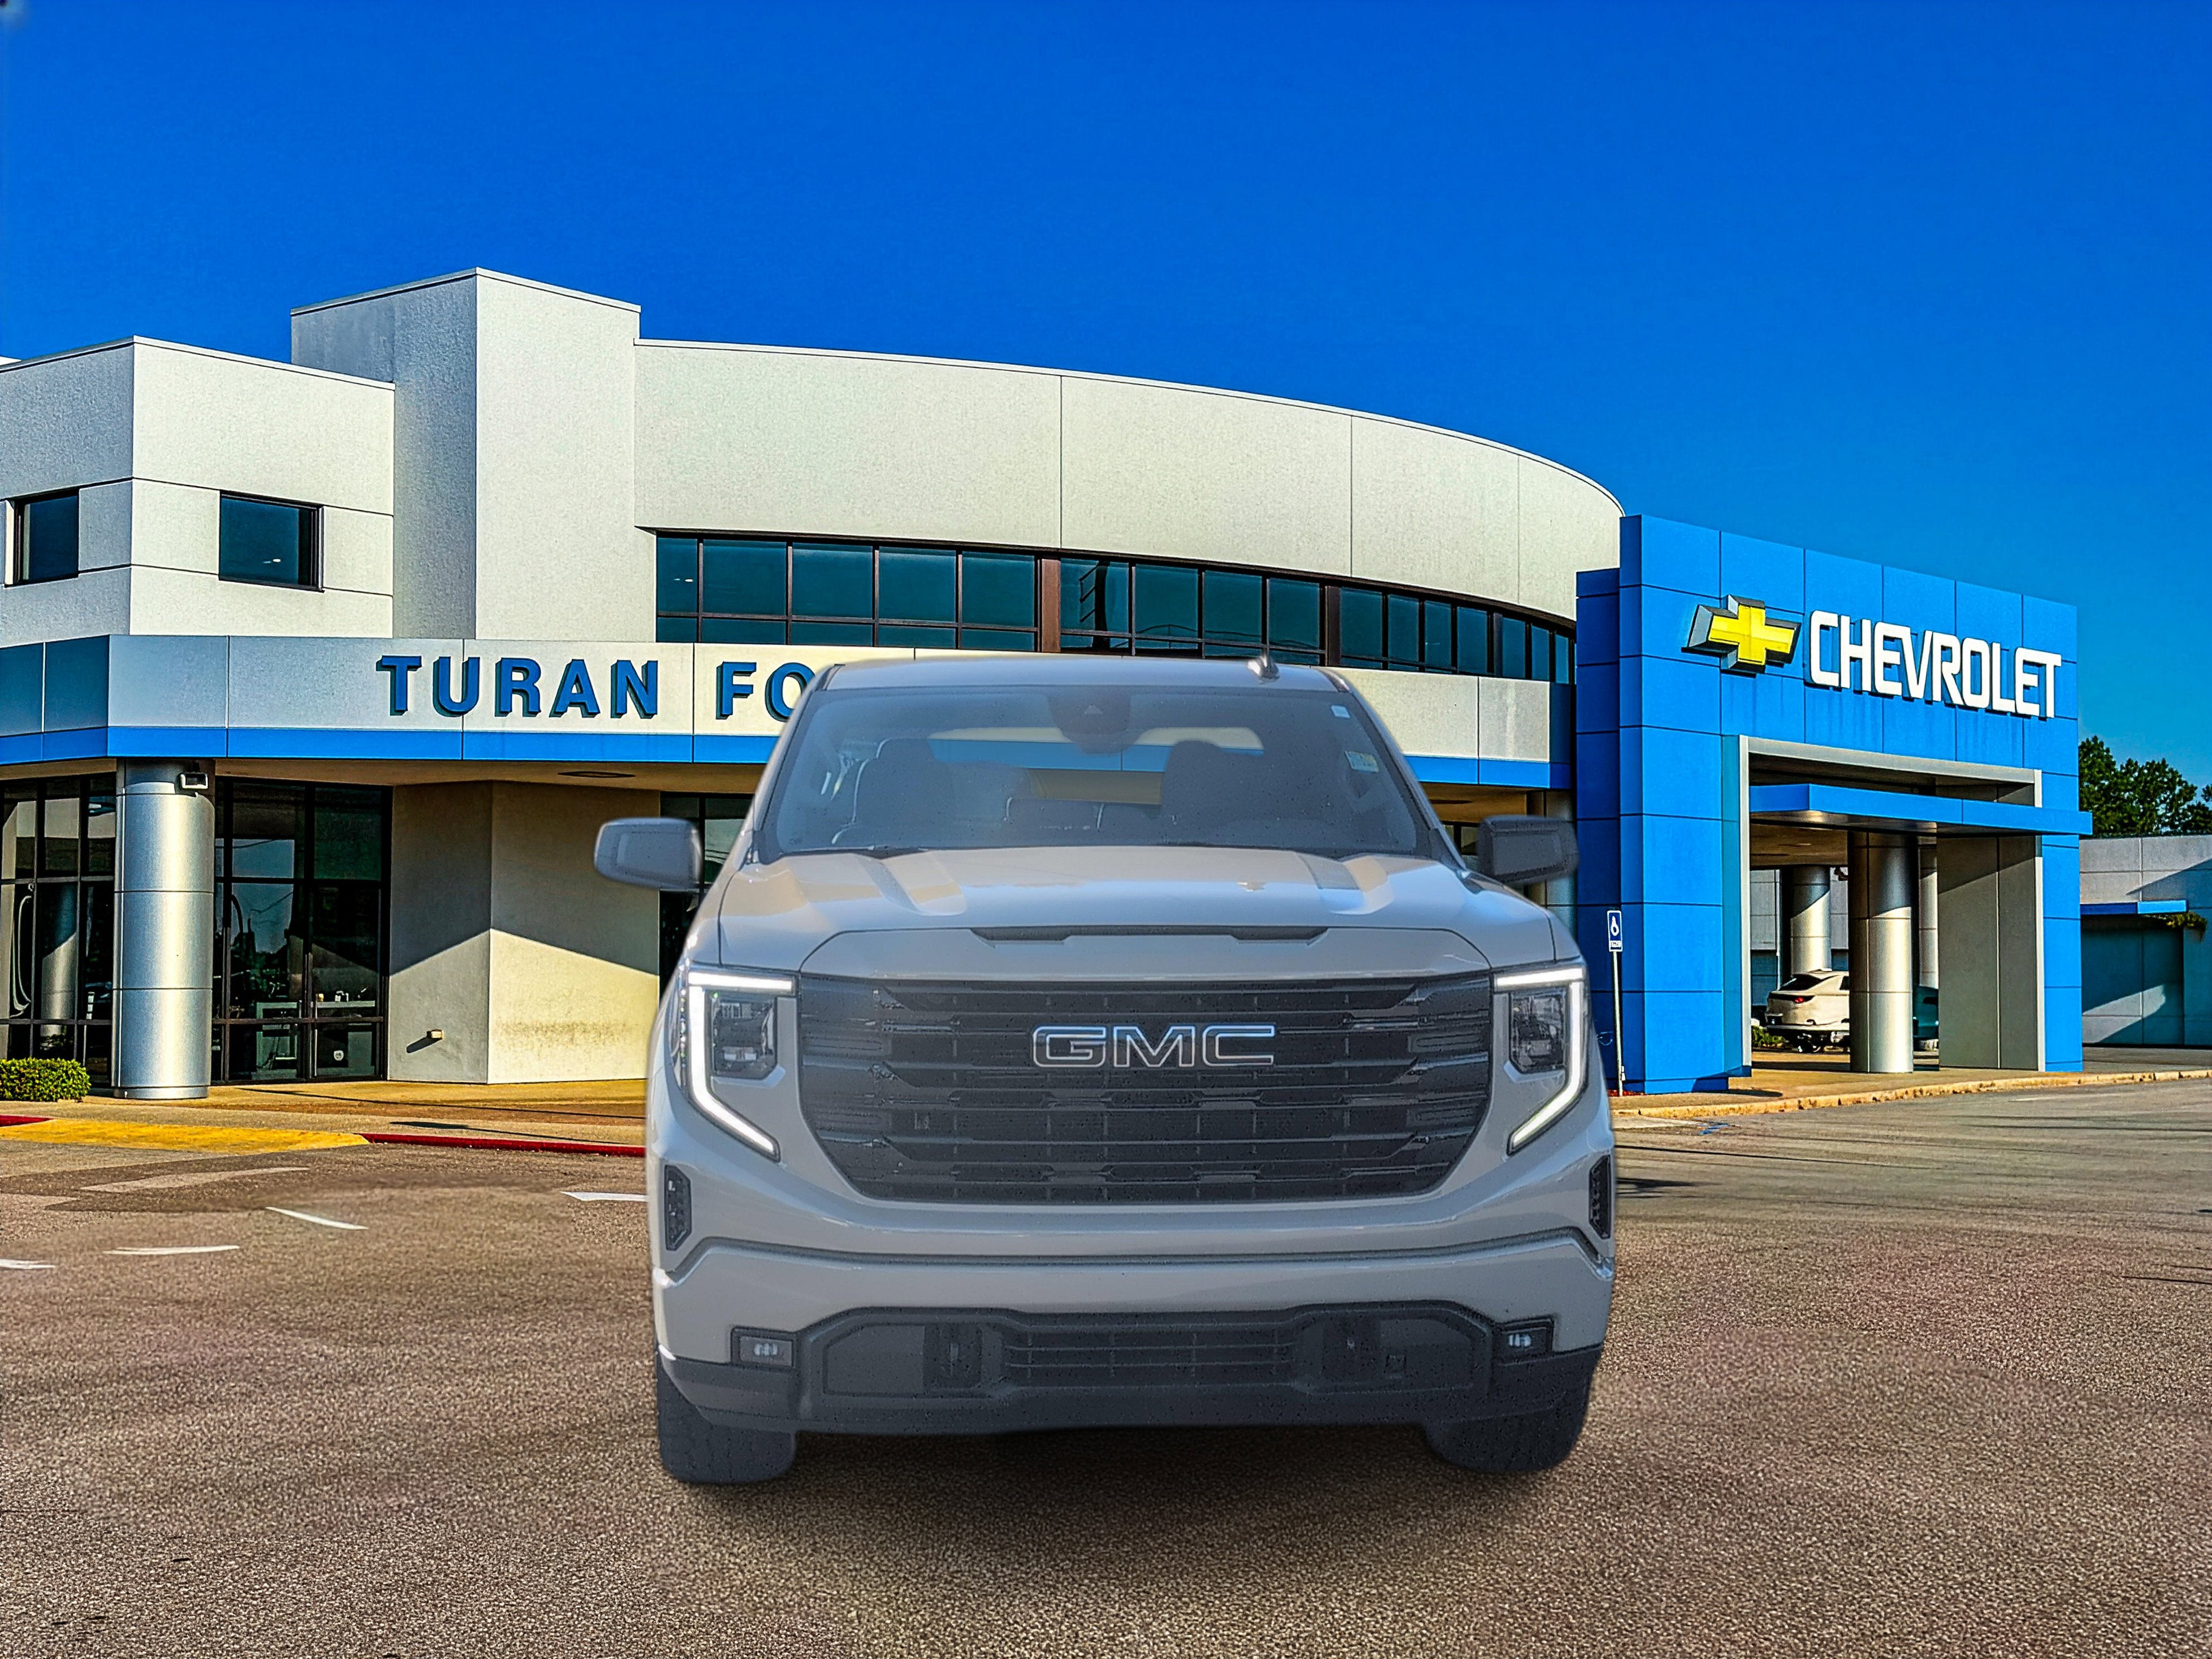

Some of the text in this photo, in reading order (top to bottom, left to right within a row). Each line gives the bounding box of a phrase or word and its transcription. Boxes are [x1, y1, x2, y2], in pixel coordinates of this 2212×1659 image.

[376, 655, 659, 719] TURAN
[1809, 610, 2062, 718] CHEVROLET
[1032, 1025, 1276, 1068] GMC
